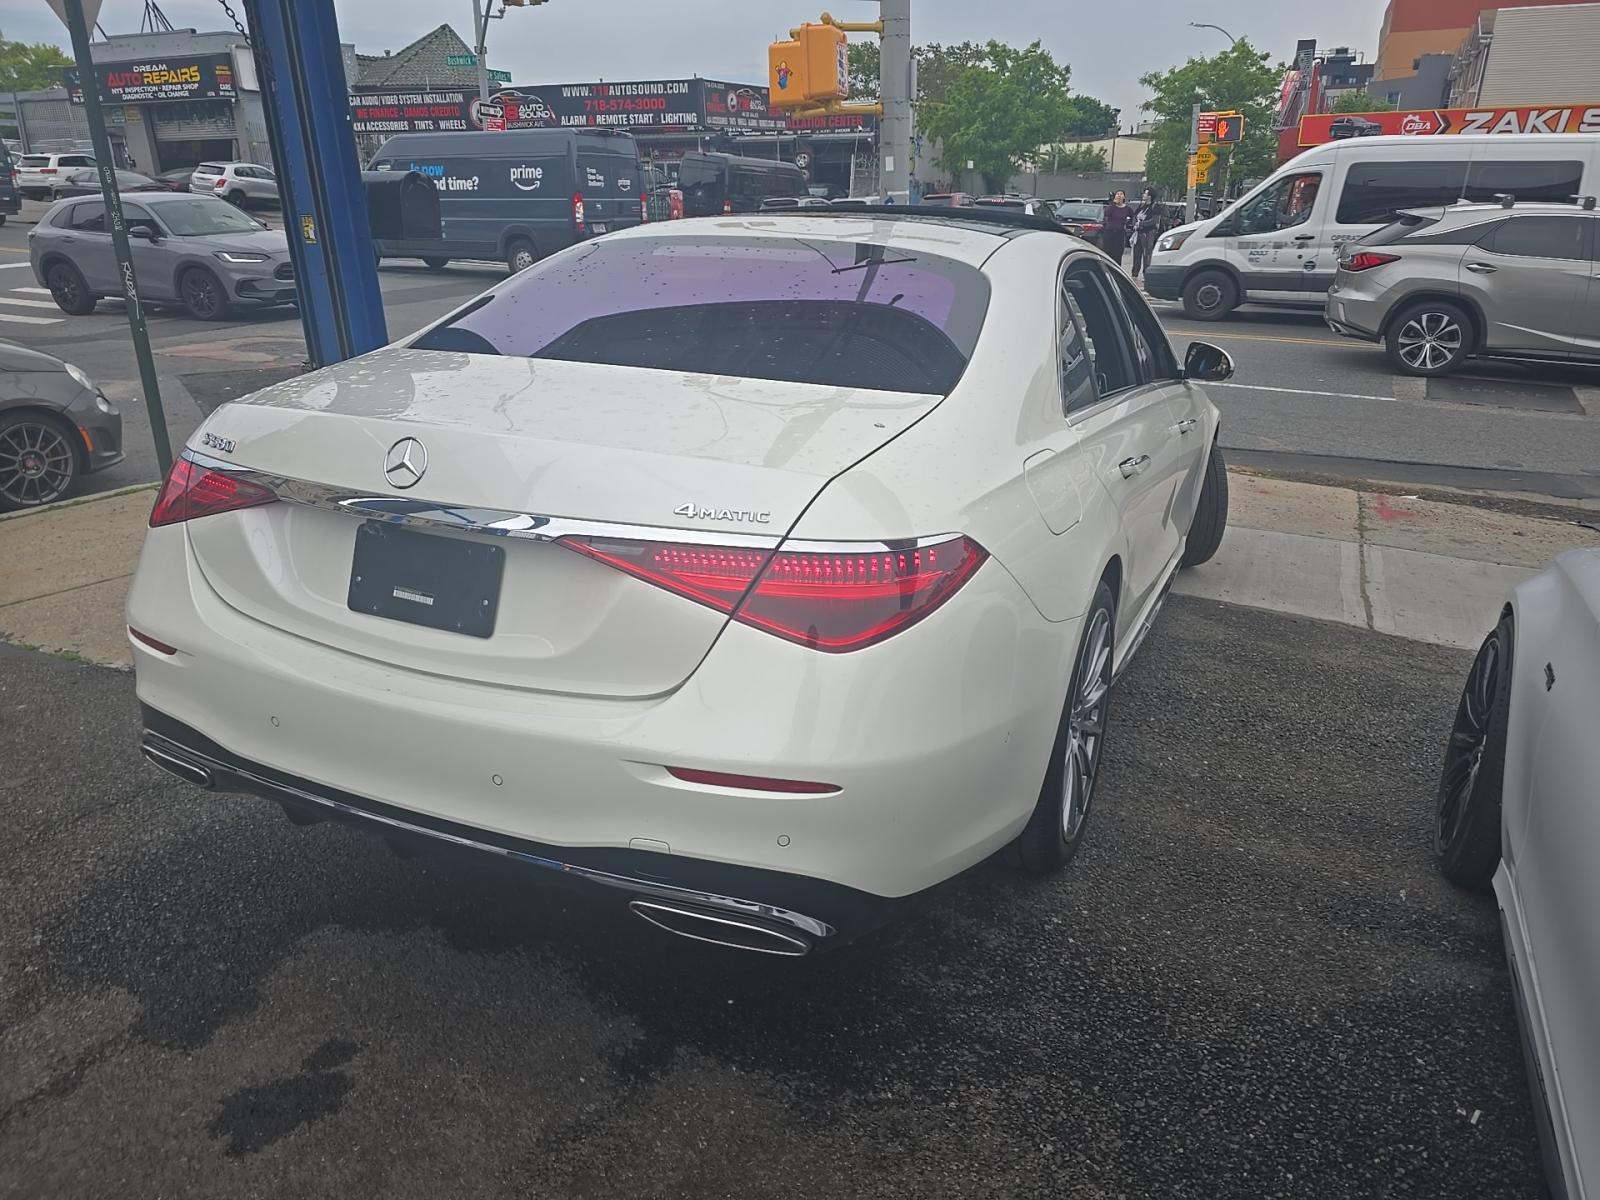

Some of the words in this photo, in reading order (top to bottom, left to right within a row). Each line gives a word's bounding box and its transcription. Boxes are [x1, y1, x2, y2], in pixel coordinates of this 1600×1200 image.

[447, 55, 471, 66] Bushwick
[133, 64, 167, 73] DREAM
[107, 71, 142, 87] AUTO
[143, 65, 201, 85] REPAIRS
[122, 92, 154, 101] DIAGNOSTIC
[167, 90, 190, 98] CHANGE
[125, 85, 158, 94] INSPECTION
[349, 96, 361, 106] CAR
[399, 94, 422, 104] SYSTEM
[422, 93, 464, 104] INSTALLATION
[583, 98, 666, 111] 718-574-3000
[356, 108, 368, 118] WE
[369, 107, 398, 118] FINANCE
[431, 105, 460, 117] CREDITO
[518, 110, 550, 119] SOUND
[366, 121, 409, 131] ACCESSORIES
[414, 120, 434, 130] TINTS
[439, 119, 467, 130] WHEELS
[561, 115, 587, 126] ALARM
[596, 114, 628, 125] REMOTE
[629, 113, 653, 124] START
[661, 112, 698, 124] LIGHTING
[829, 114, 863, 128] CENTER
[1460, 108, 1573, 135] ZAKI
[510, 164, 543, 182] prime
[447, 175, 479, 191] time?
[673, 502, 771, 524] 4MATIC
